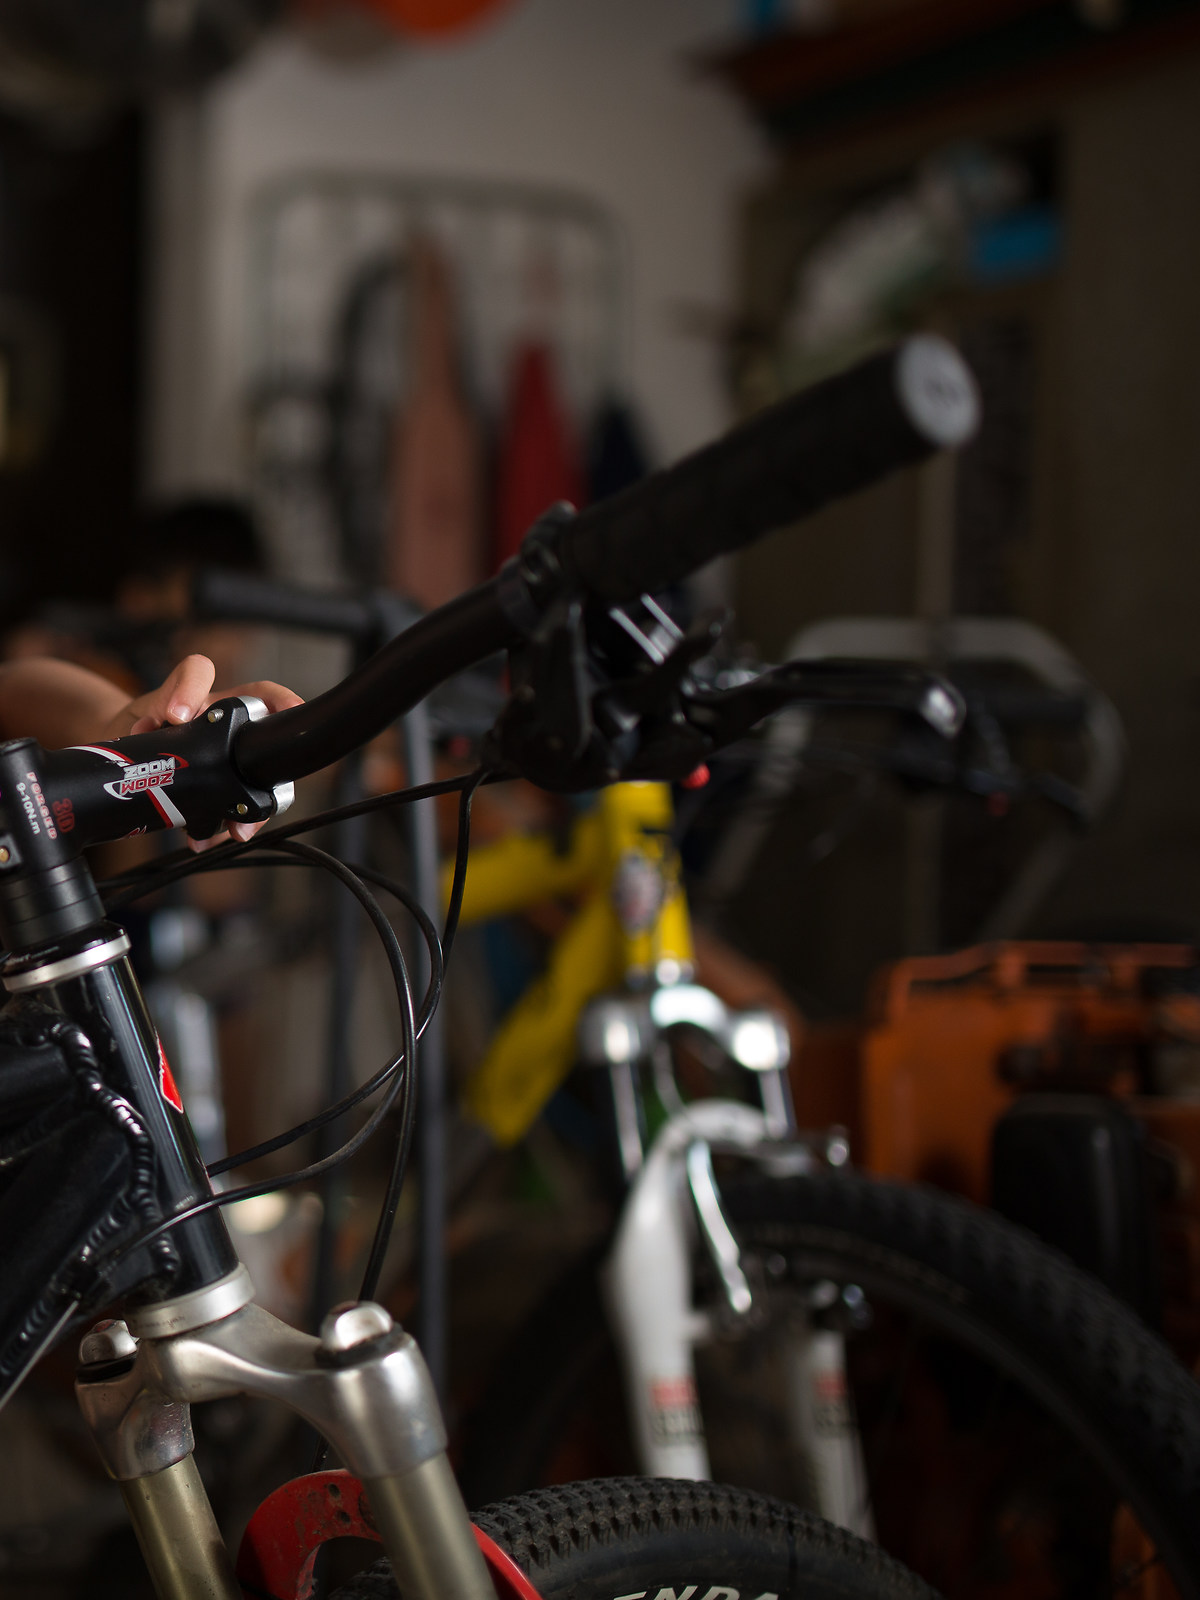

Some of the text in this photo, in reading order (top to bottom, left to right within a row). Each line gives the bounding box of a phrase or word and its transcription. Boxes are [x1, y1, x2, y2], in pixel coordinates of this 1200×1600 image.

[124, 758, 175, 779] ZOOM
[27, 772, 57, 838] FORGED
[53, 799, 74, 832] 3D
